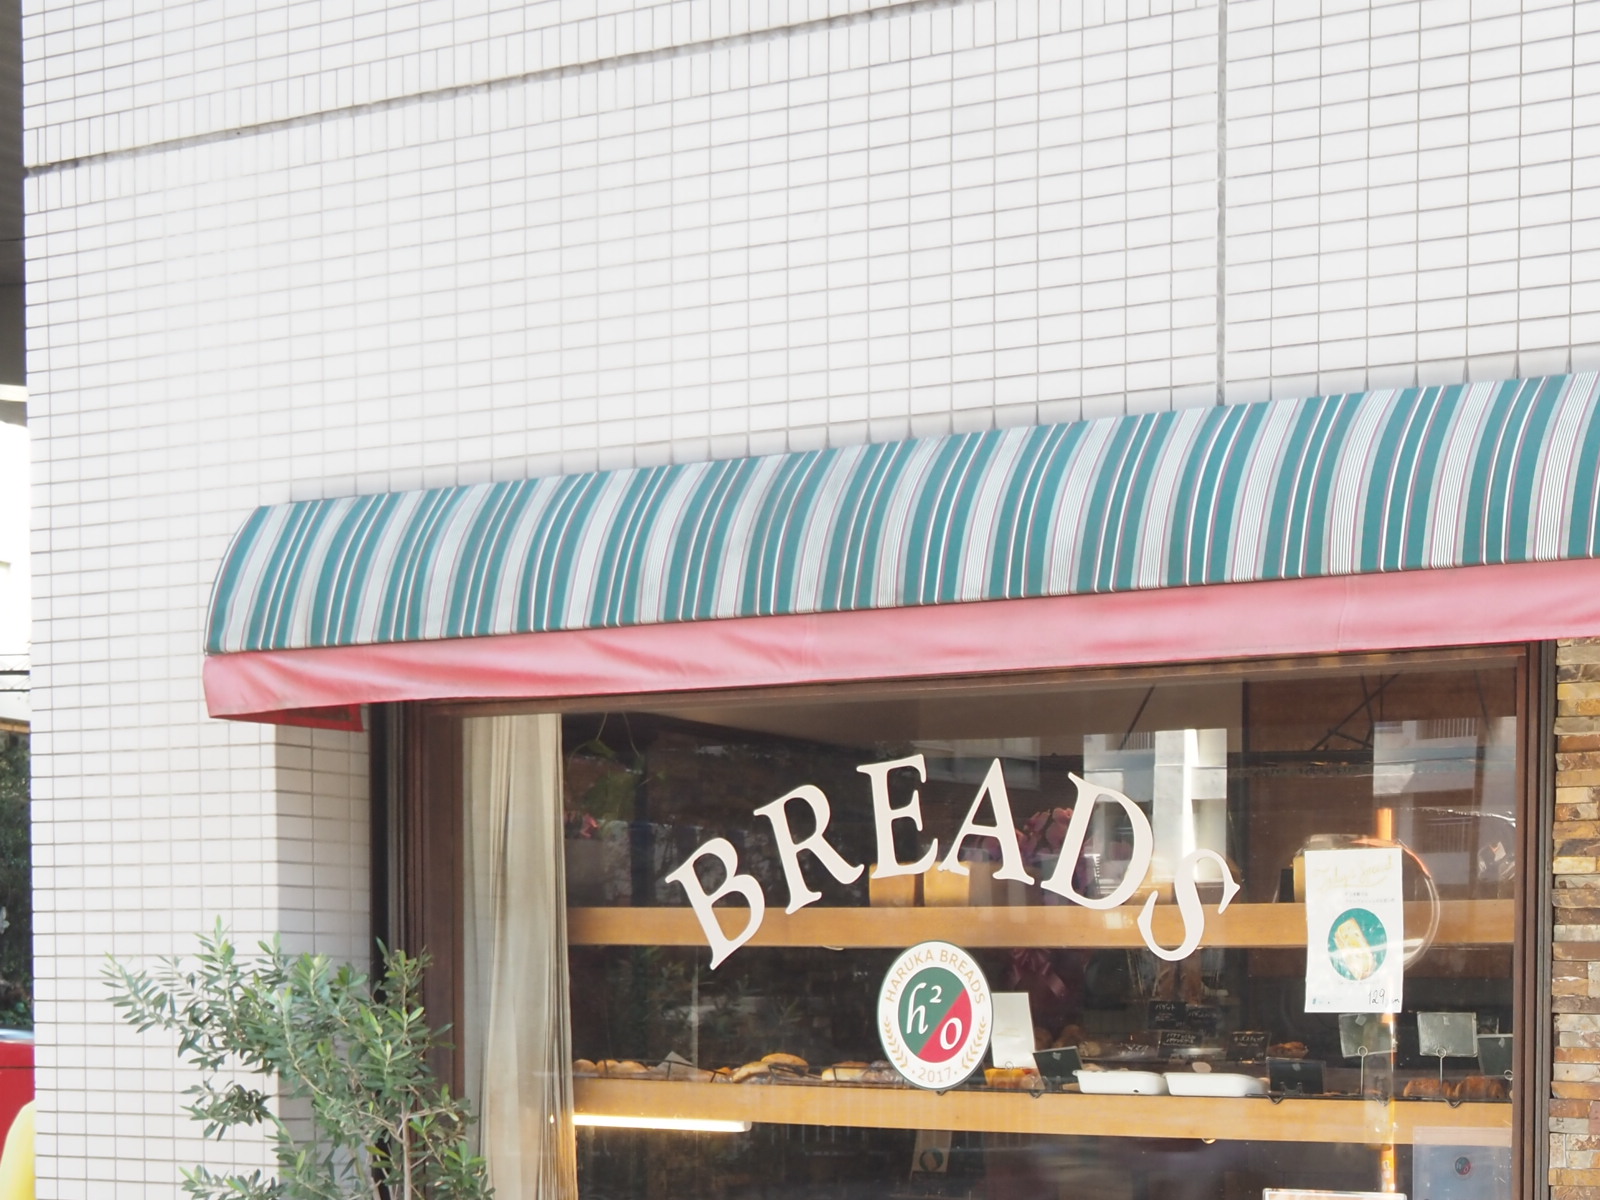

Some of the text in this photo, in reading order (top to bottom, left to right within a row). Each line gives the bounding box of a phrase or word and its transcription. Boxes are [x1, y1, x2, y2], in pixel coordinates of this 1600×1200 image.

[665, 753, 1241, 970] BREADS
[885, 949, 986, 1004] HARUKA BREADS
[917, 1067, 951, 1083] 2017
